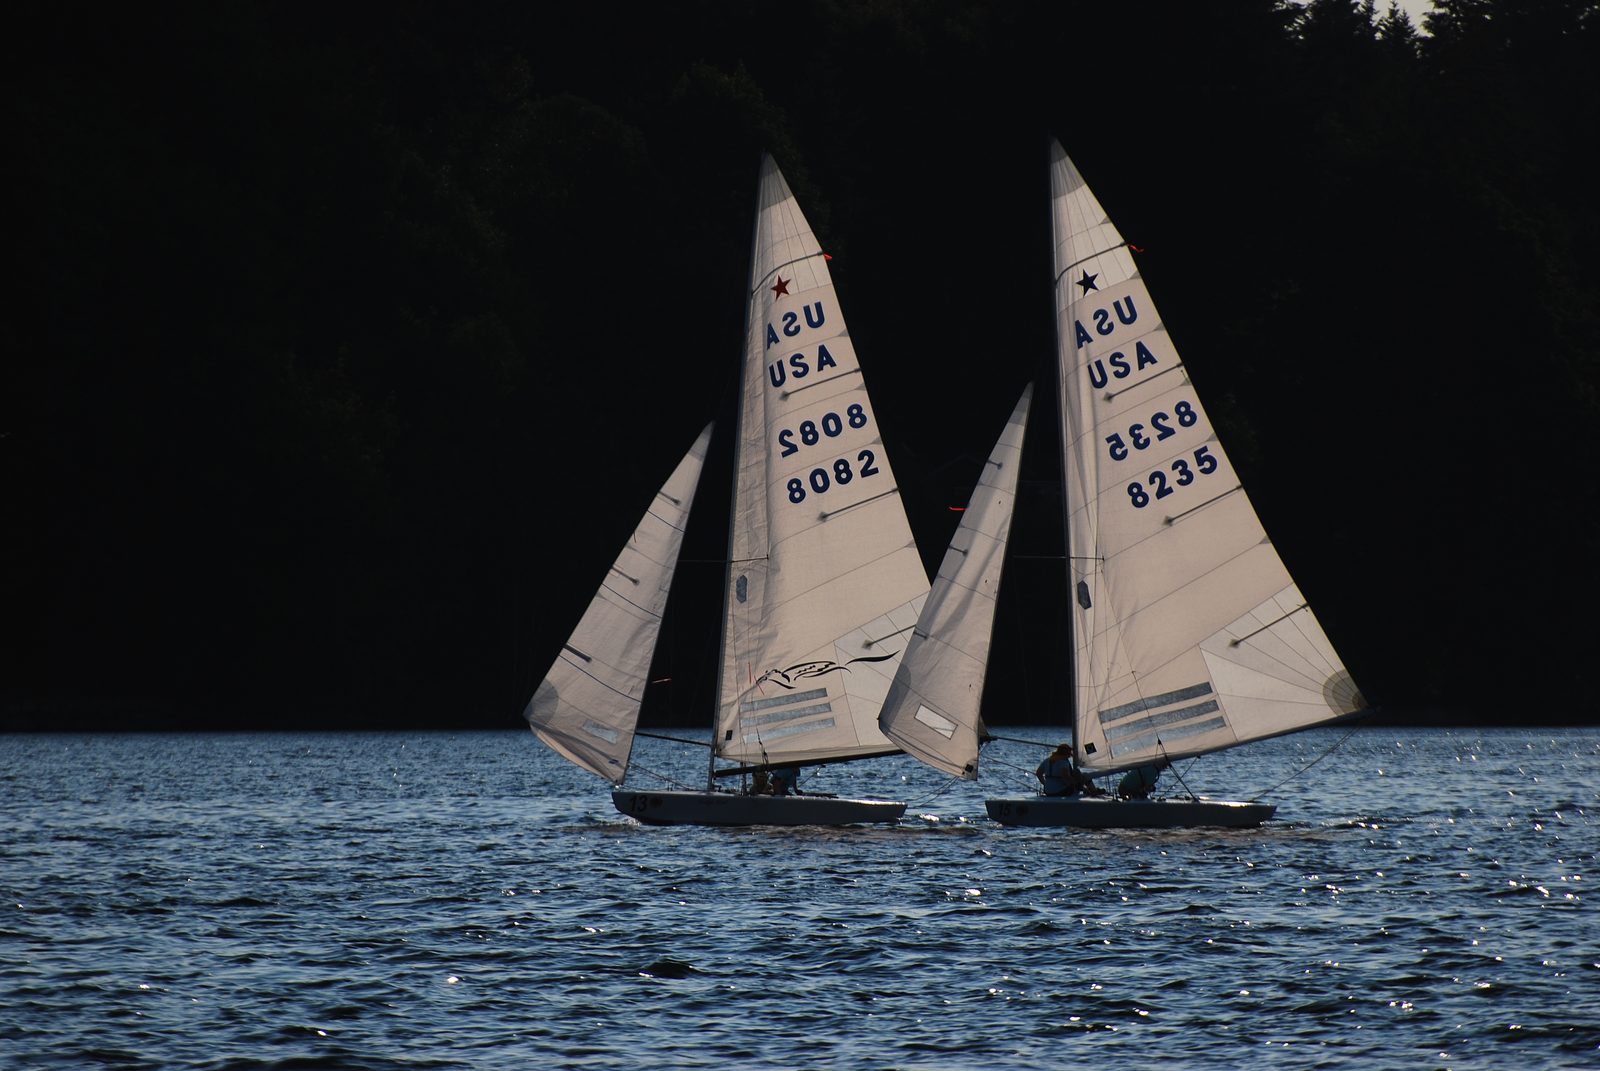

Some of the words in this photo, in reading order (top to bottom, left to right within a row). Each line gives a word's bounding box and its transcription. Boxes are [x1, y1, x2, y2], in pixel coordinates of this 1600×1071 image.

[769, 344, 837, 388] USA
[1088, 341, 1158, 389] USA
[787, 449, 879, 504] 8082
[1127, 446, 1217, 508] 8235
[630, 795, 647, 812] 13
